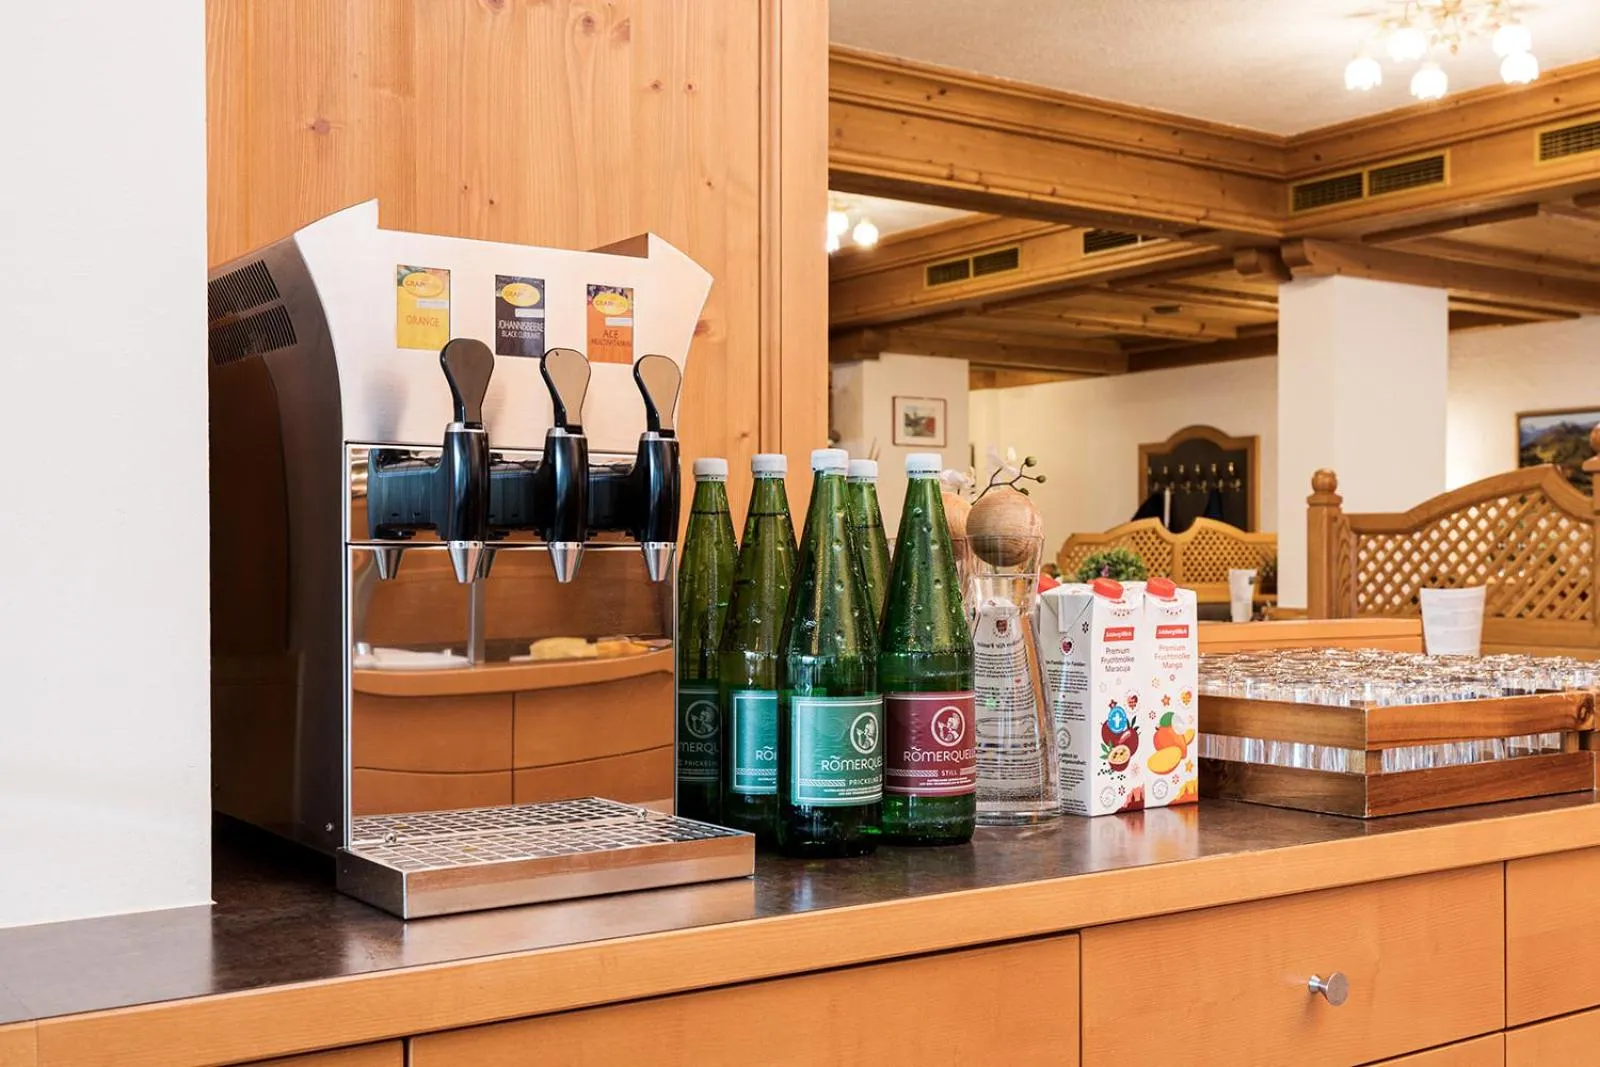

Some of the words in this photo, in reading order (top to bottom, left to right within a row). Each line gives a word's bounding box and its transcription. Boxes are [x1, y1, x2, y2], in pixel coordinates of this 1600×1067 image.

[405, 314, 441, 328] ORANGE
[602, 328, 619, 339] ACE
[1105, 647, 1130, 655] Premium
[1104, 664, 1131, 673] Maracuja
[1162, 661, 1184, 670] Mango
